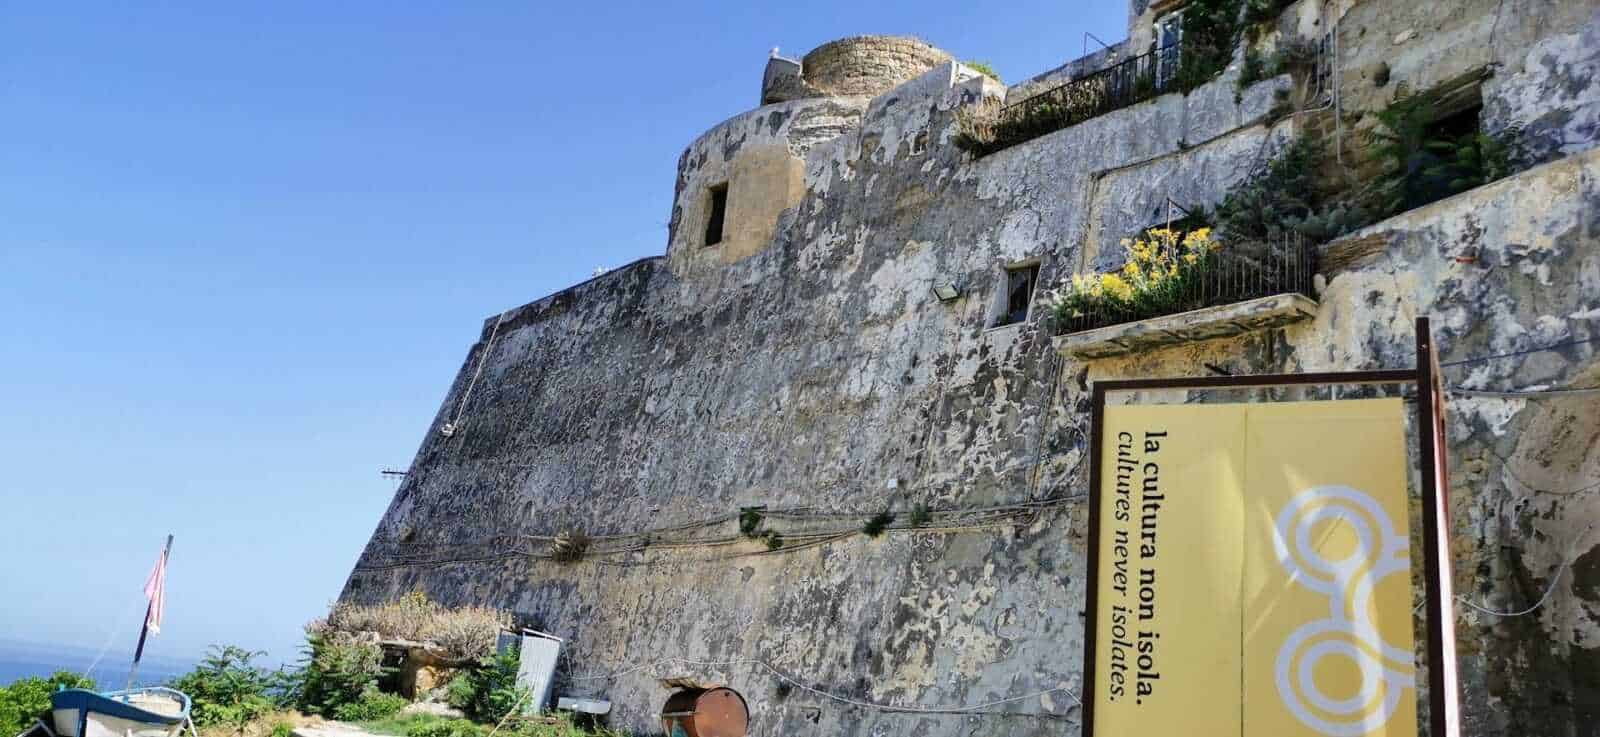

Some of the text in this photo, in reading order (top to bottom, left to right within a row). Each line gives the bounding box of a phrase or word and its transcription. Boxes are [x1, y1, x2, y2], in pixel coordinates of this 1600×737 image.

[1109, 431, 1139, 702] cultures never isolates.
[1136, 431, 1168, 705] la cultura non isola.
